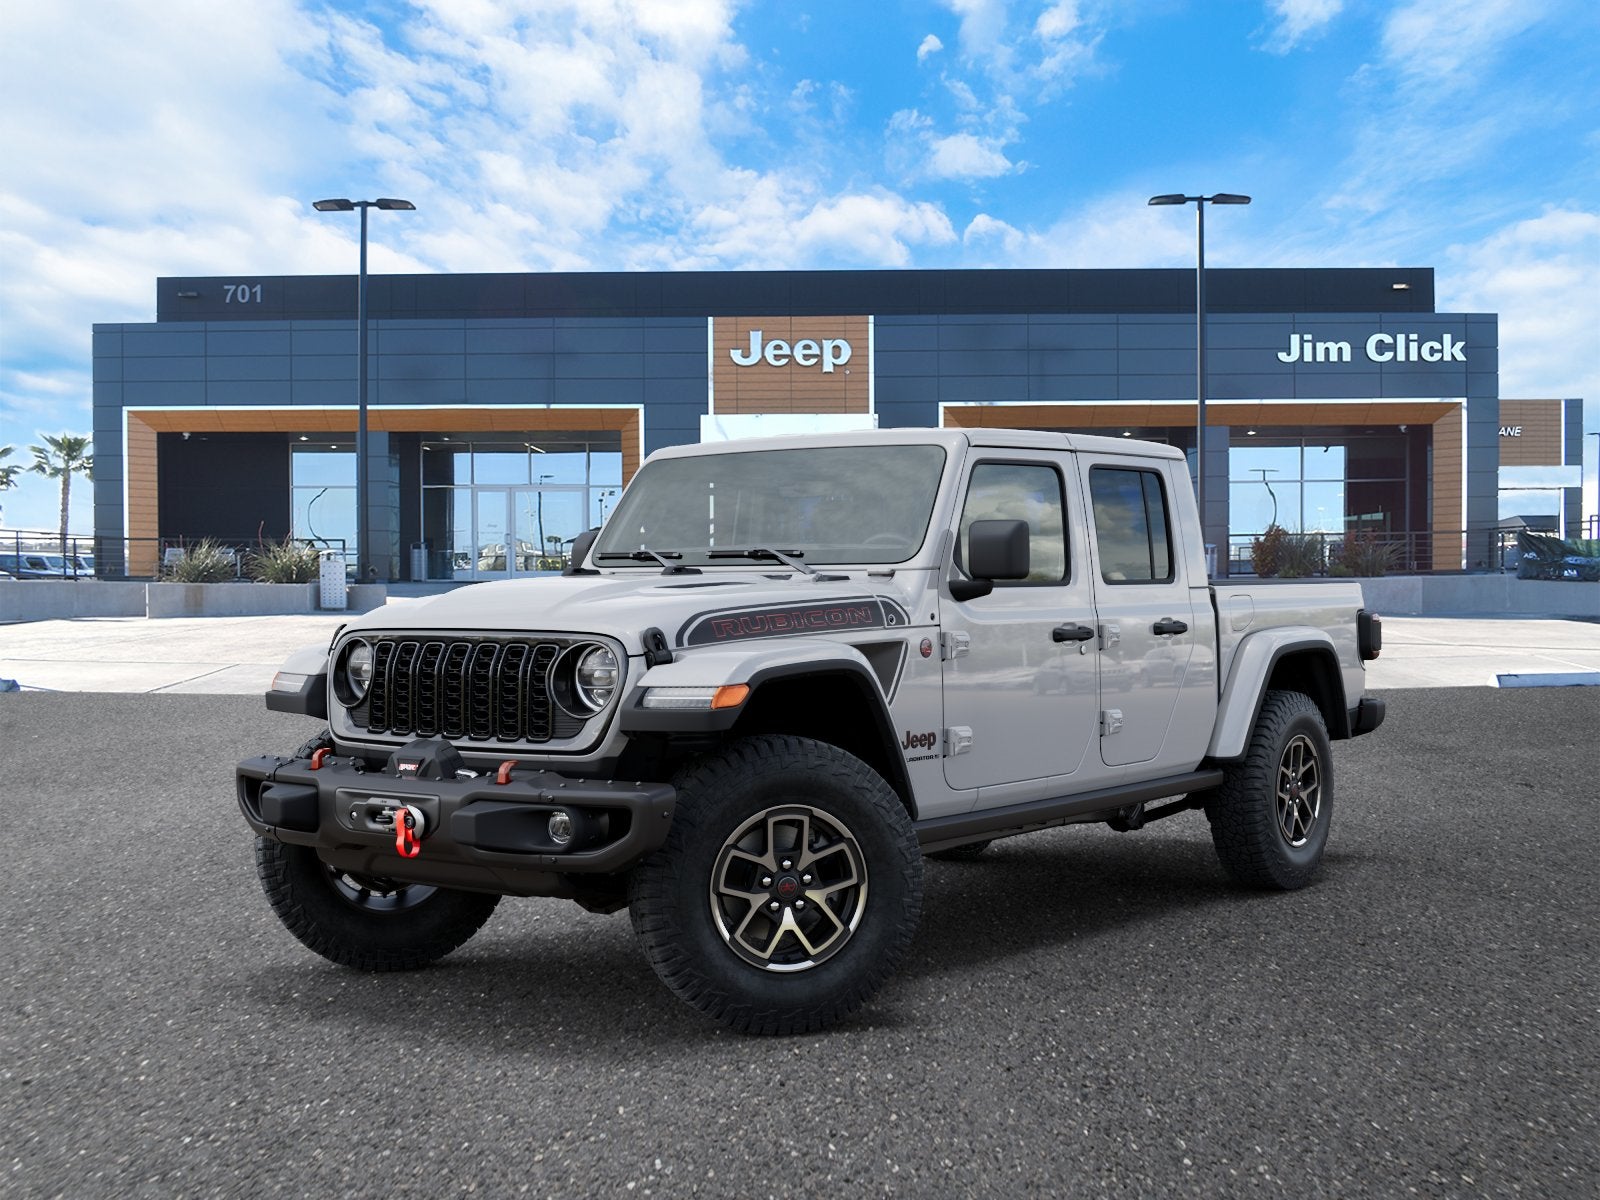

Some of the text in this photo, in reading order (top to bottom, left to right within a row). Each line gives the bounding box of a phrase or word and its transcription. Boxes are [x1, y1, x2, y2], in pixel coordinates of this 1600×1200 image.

[223, 284, 262, 303] 701
[729, 331, 852, 373] Jeep
[1277, 333, 1467, 362] Jim Click
[1498, 426, 1522, 437] ANE
[711, 607, 873, 638] RUBICON
[901, 730, 937, 751] Jeep
